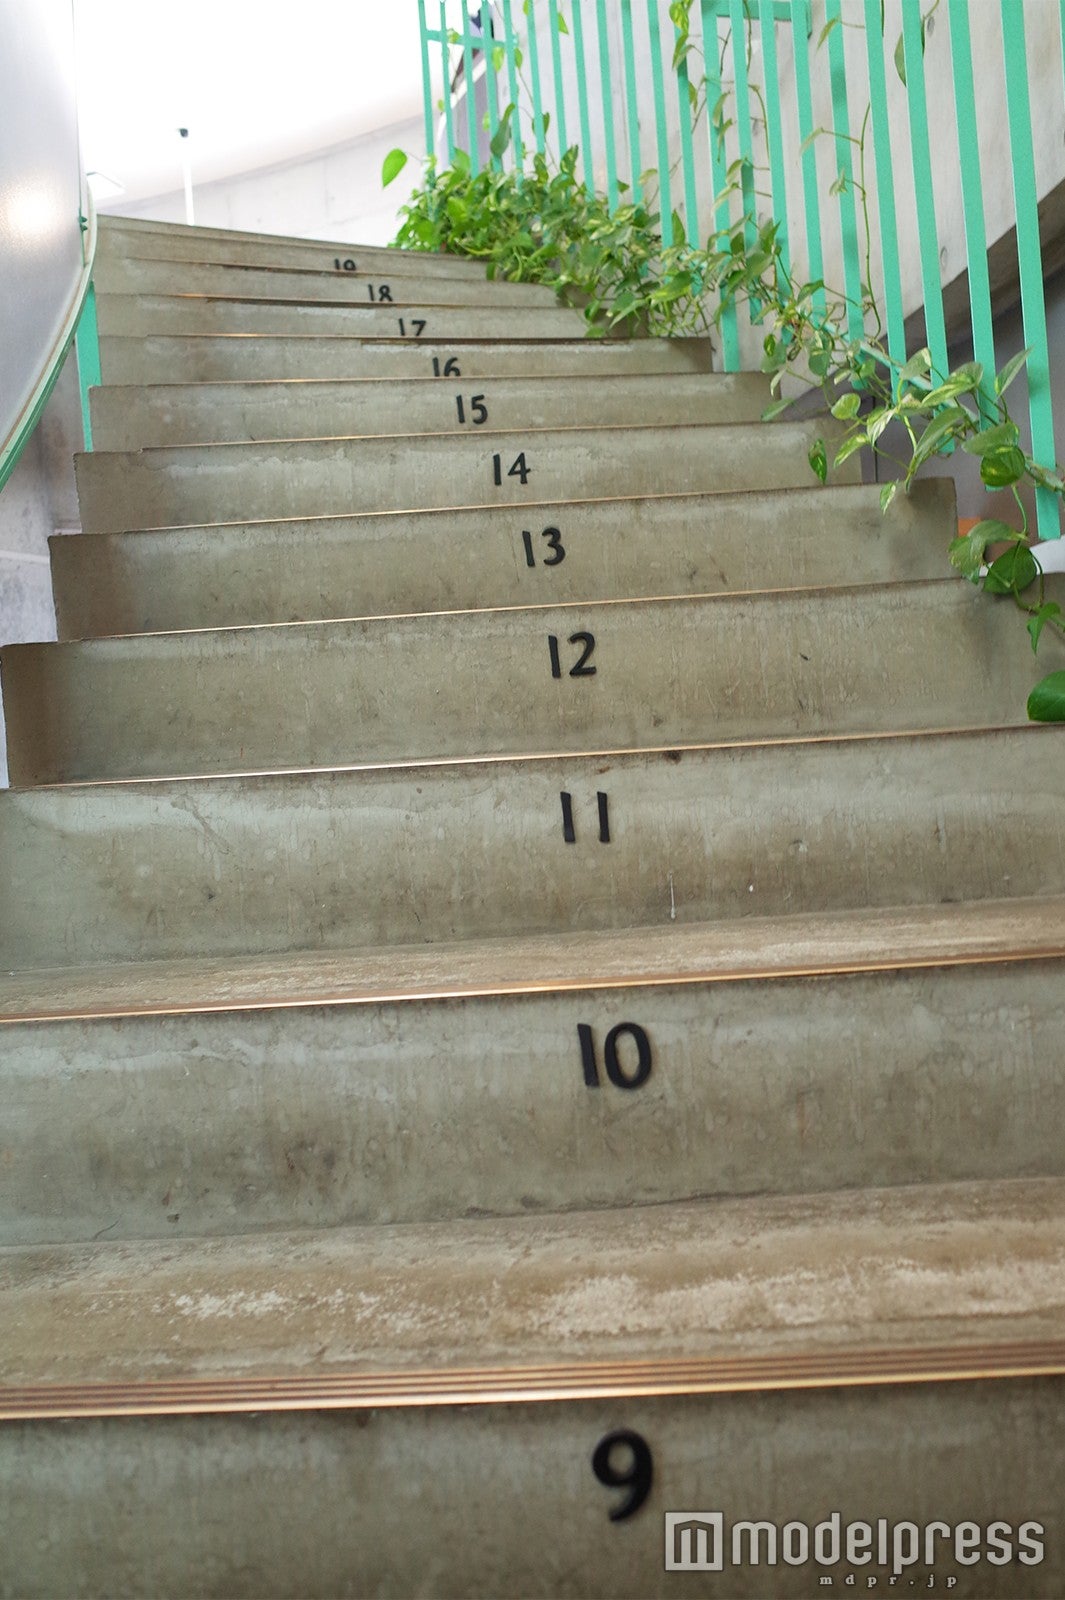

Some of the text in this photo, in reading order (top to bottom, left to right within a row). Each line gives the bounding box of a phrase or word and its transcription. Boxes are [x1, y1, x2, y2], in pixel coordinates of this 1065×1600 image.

[368, 284, 393, 302] 18
[398, 318, 427, 336] 17
[433, 357, 461, 377] 16
[456, 395, 488, 425] 15
[493, 453, 532, 486] 14
[522, 527, 565, 567] 13
[548, 631, 597, 679] 12
[560, 791, 611, 844] 11
[577, 1022, 653, 1091] 10
[592, 1429, 655, 1523] 9
